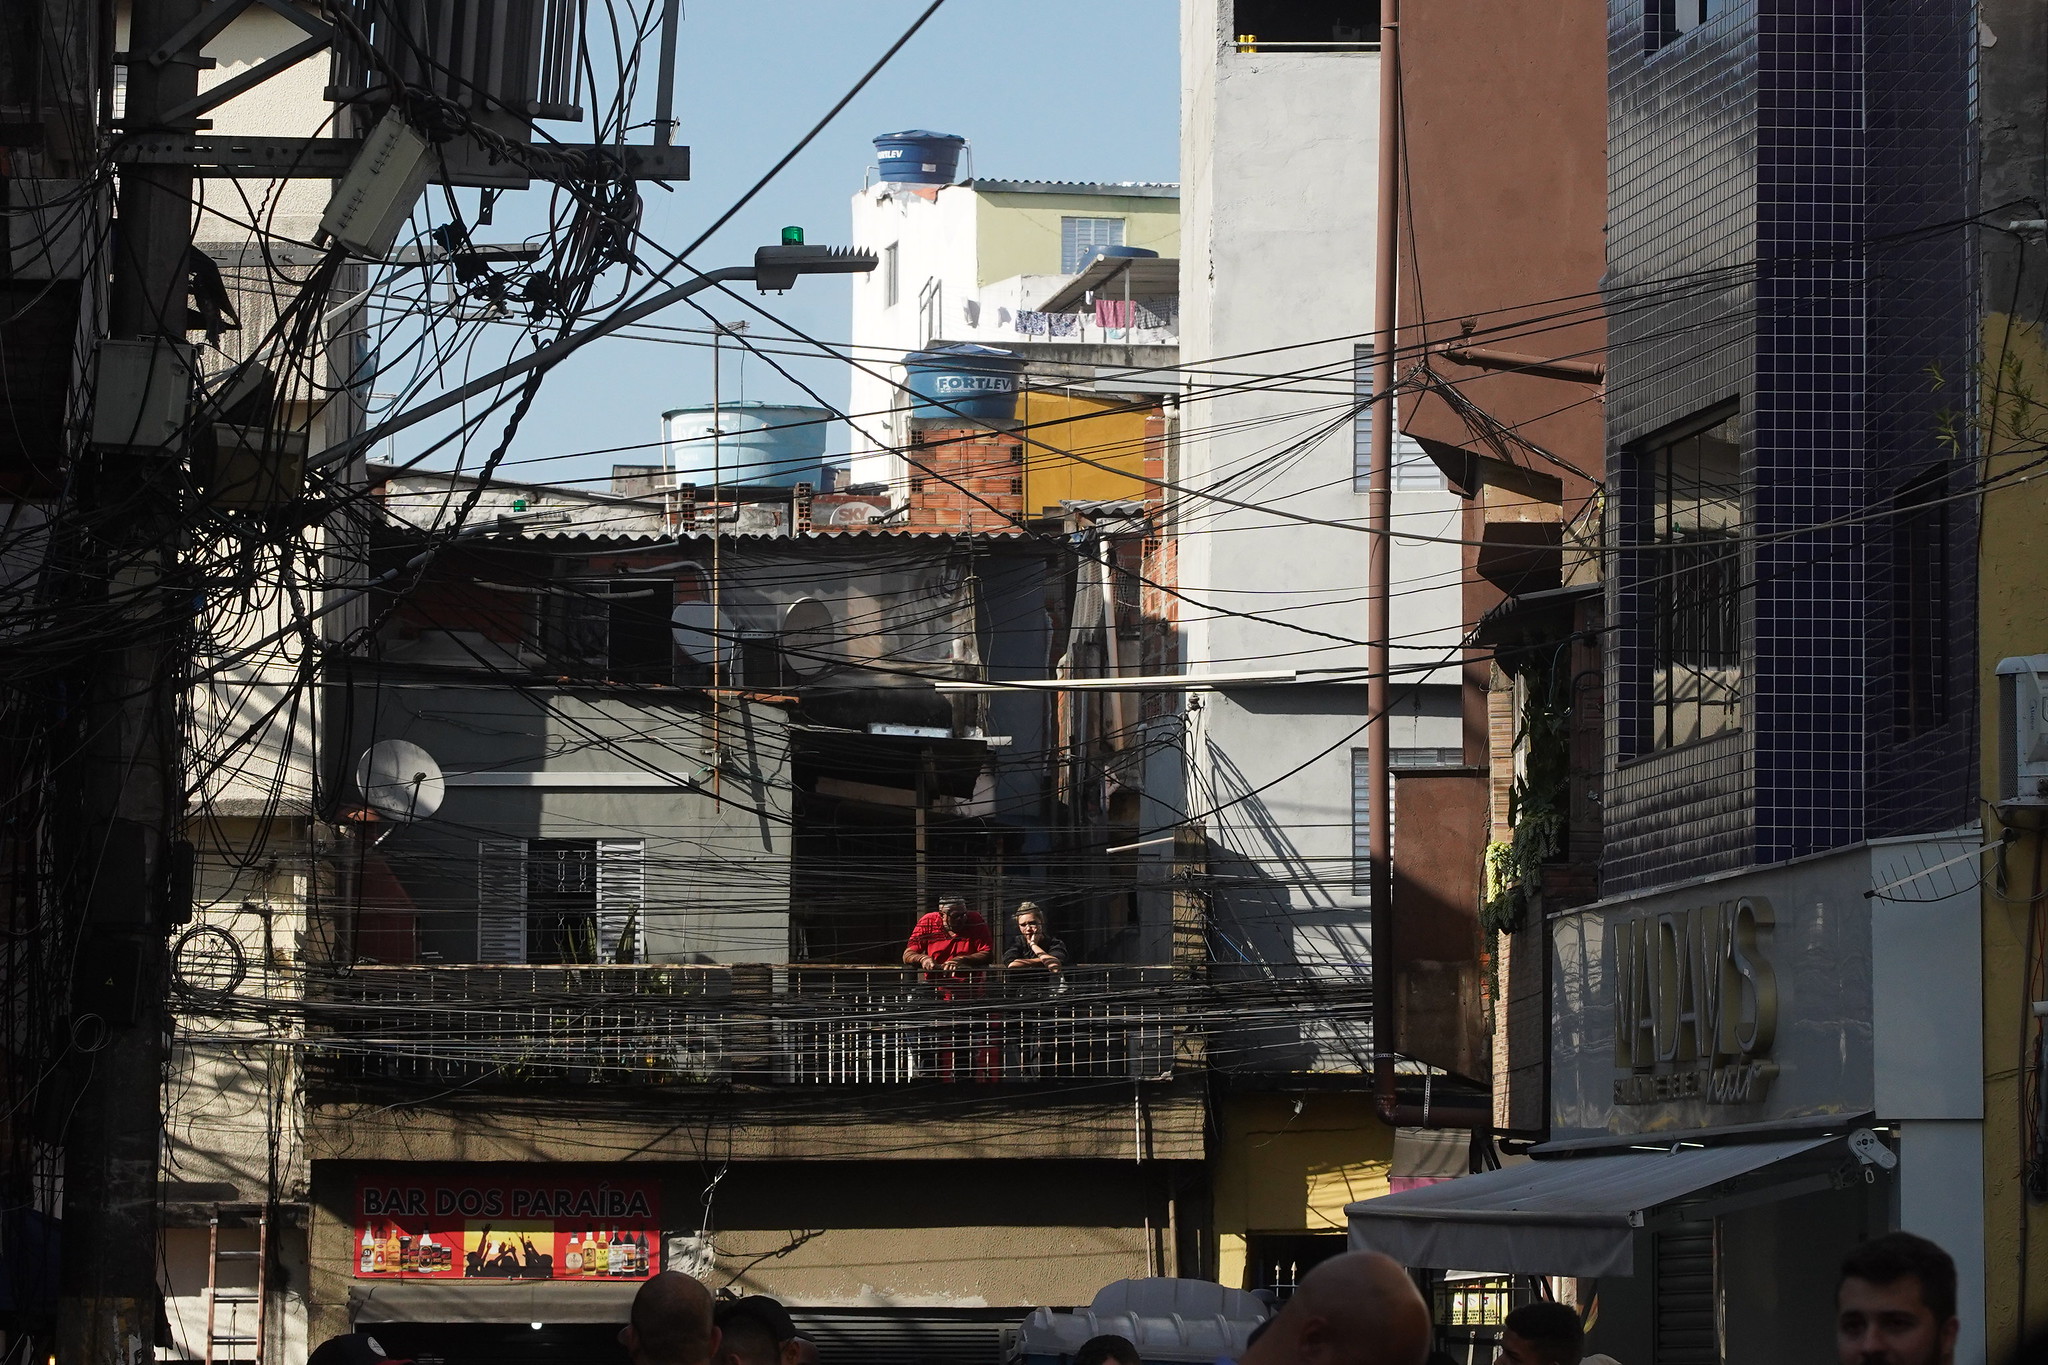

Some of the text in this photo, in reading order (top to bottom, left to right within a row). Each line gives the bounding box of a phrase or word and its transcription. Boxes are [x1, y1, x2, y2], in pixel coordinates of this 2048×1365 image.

[939, 377, 1012, 390] FORTLEV
[838, 506, 869, 521] SKY
[363, 1181, 652, 1218] BAR DOS PARAÍBA
